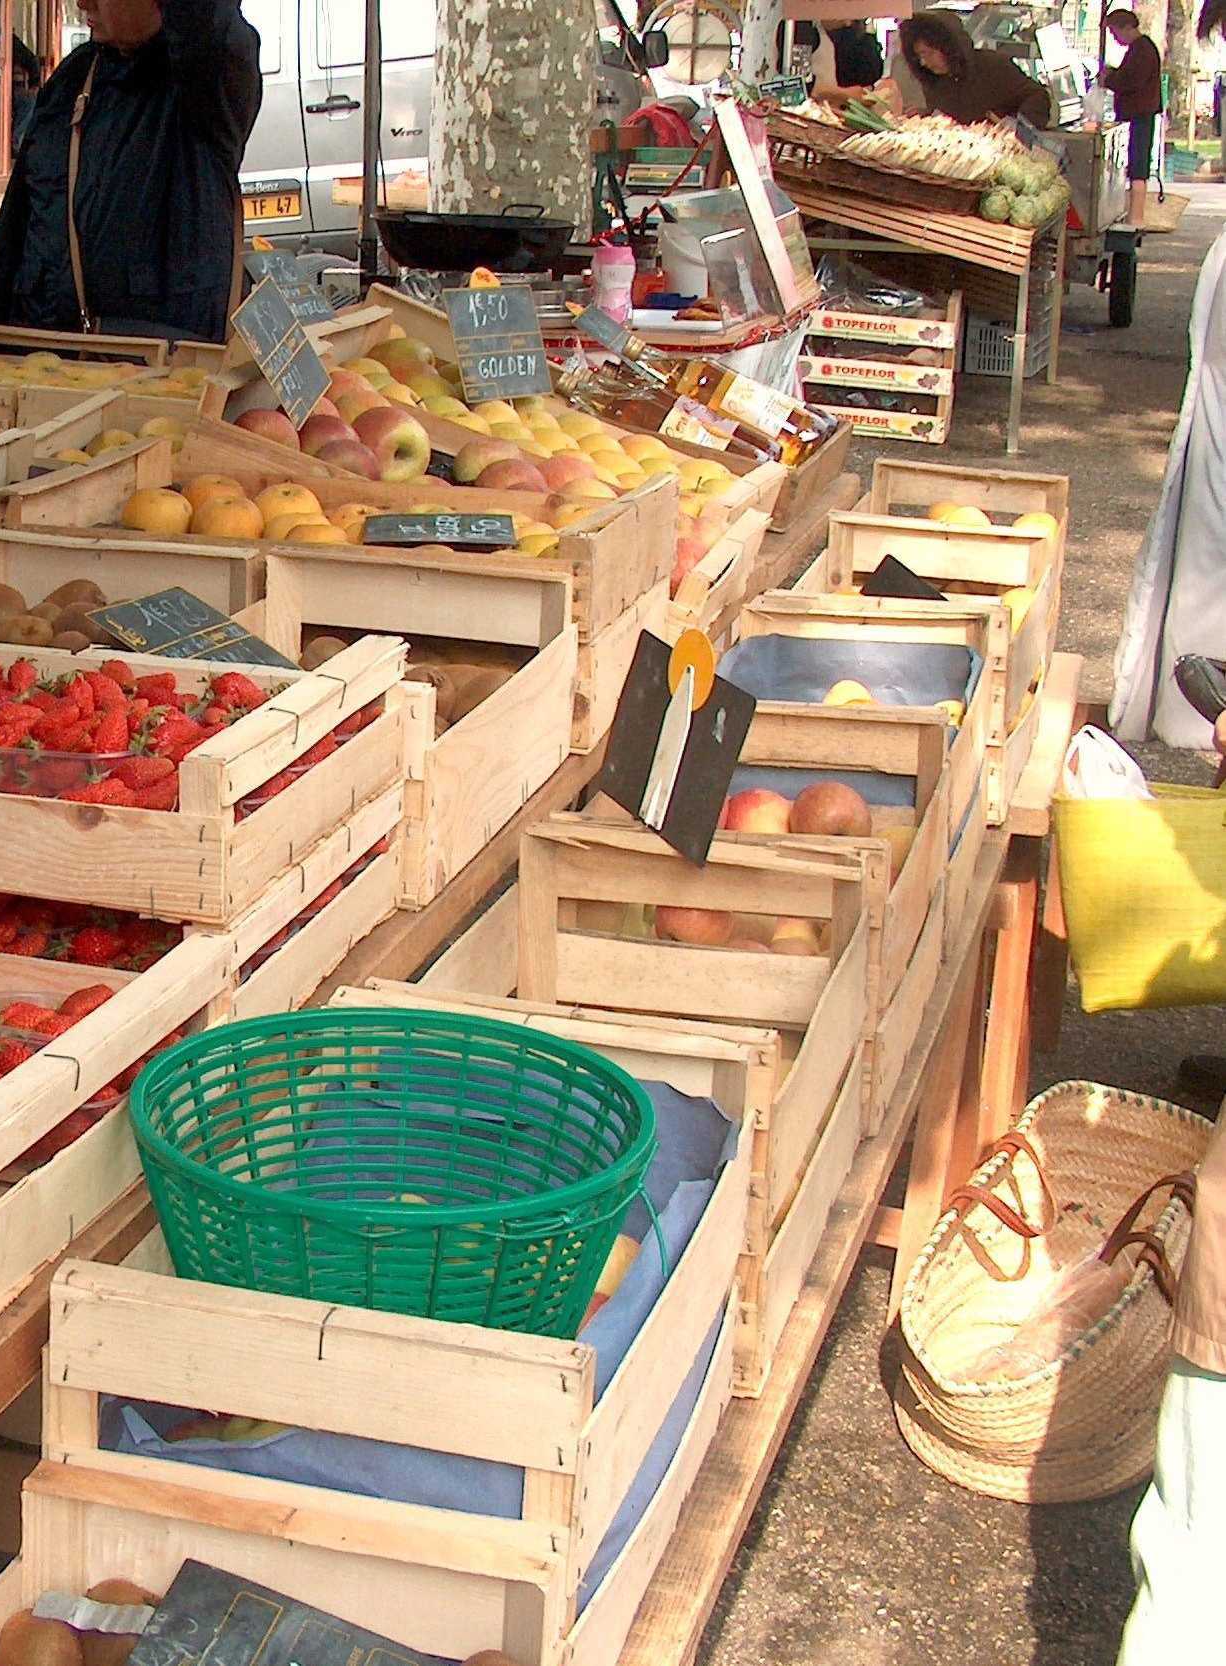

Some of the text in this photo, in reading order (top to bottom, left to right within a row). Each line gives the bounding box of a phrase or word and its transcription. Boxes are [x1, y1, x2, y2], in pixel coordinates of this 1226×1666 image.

[250, 196, 292, 217] TF 47
[836, 319, 896, 333] TOPEFLOR
[478, 355, 537, 380] GOLDEN
[835, 365, 895, 379] TOPEFLOR
[832, 413, 889, 427] OPEFLOR
